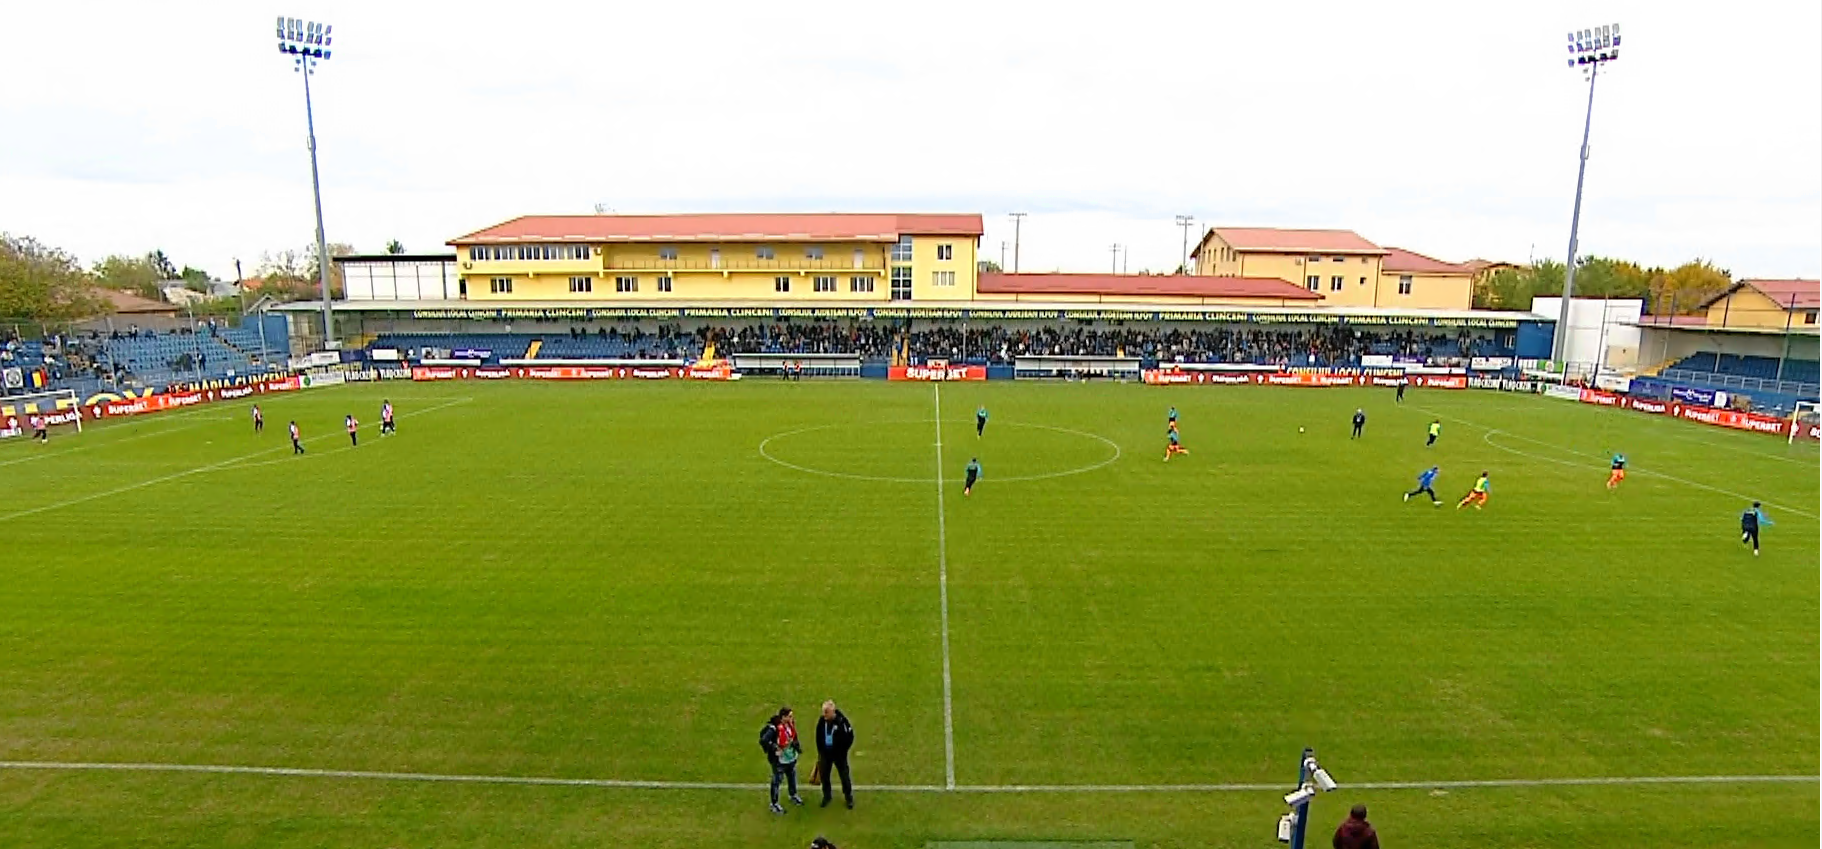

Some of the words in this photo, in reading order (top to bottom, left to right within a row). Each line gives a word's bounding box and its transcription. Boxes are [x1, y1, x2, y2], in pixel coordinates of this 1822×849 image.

[545, 308, 587, 317] CLINCENI
[591, 308, 626, 317] CONSILIUL
[627, 308, 647, 317] LOCAL
[648, 308, 679, 317] CLINCENI
[730, 308, 773, 317] CLINCENI
[1205, 312, 1247, 320] CLINCENI
[1388, 316, 1429, 325] CLINCENI
[1631, 399, 1666, 413] SUPERLIGA
